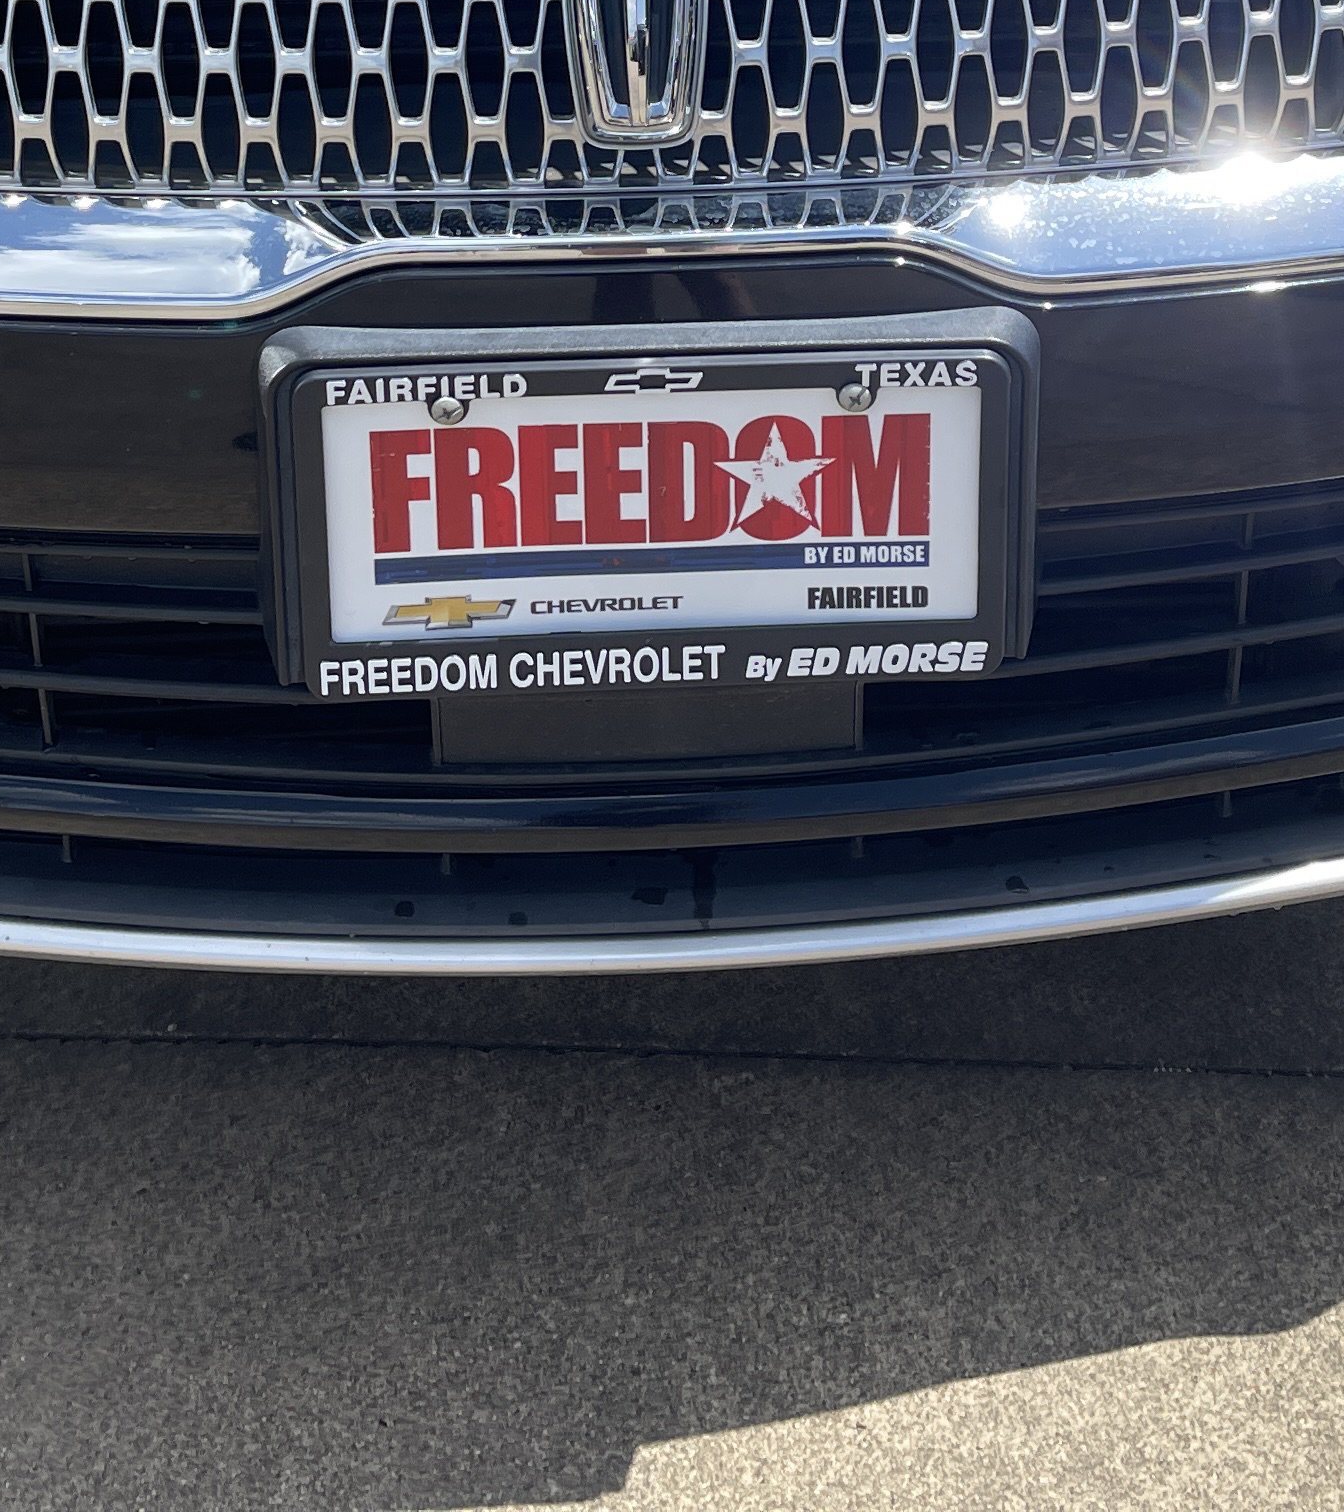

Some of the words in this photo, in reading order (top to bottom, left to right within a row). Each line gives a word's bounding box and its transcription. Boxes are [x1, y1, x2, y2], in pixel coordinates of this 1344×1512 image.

[855, 360, 979, 388] TEXAS
[325, 373, 527, 406] FAIRFIELD
[369, 413, 931, 554] FREEDOM
[804, 547, 827, 564] BY
[832, 546, 855, 563] ED
[860, 544, 925, 563] MORSE
[530, 595, 684, 615] CHEVROLET
[807, 585, 929, 610] FAIRFIELD
[319, 653, 498, 696] FREEDOM
[509, 644, 726, 689] CHEVROLET
[745, 655, 783, 682] By
[787, 647, 841, 677] ED
[845, 641, 989, 674] MORSE
